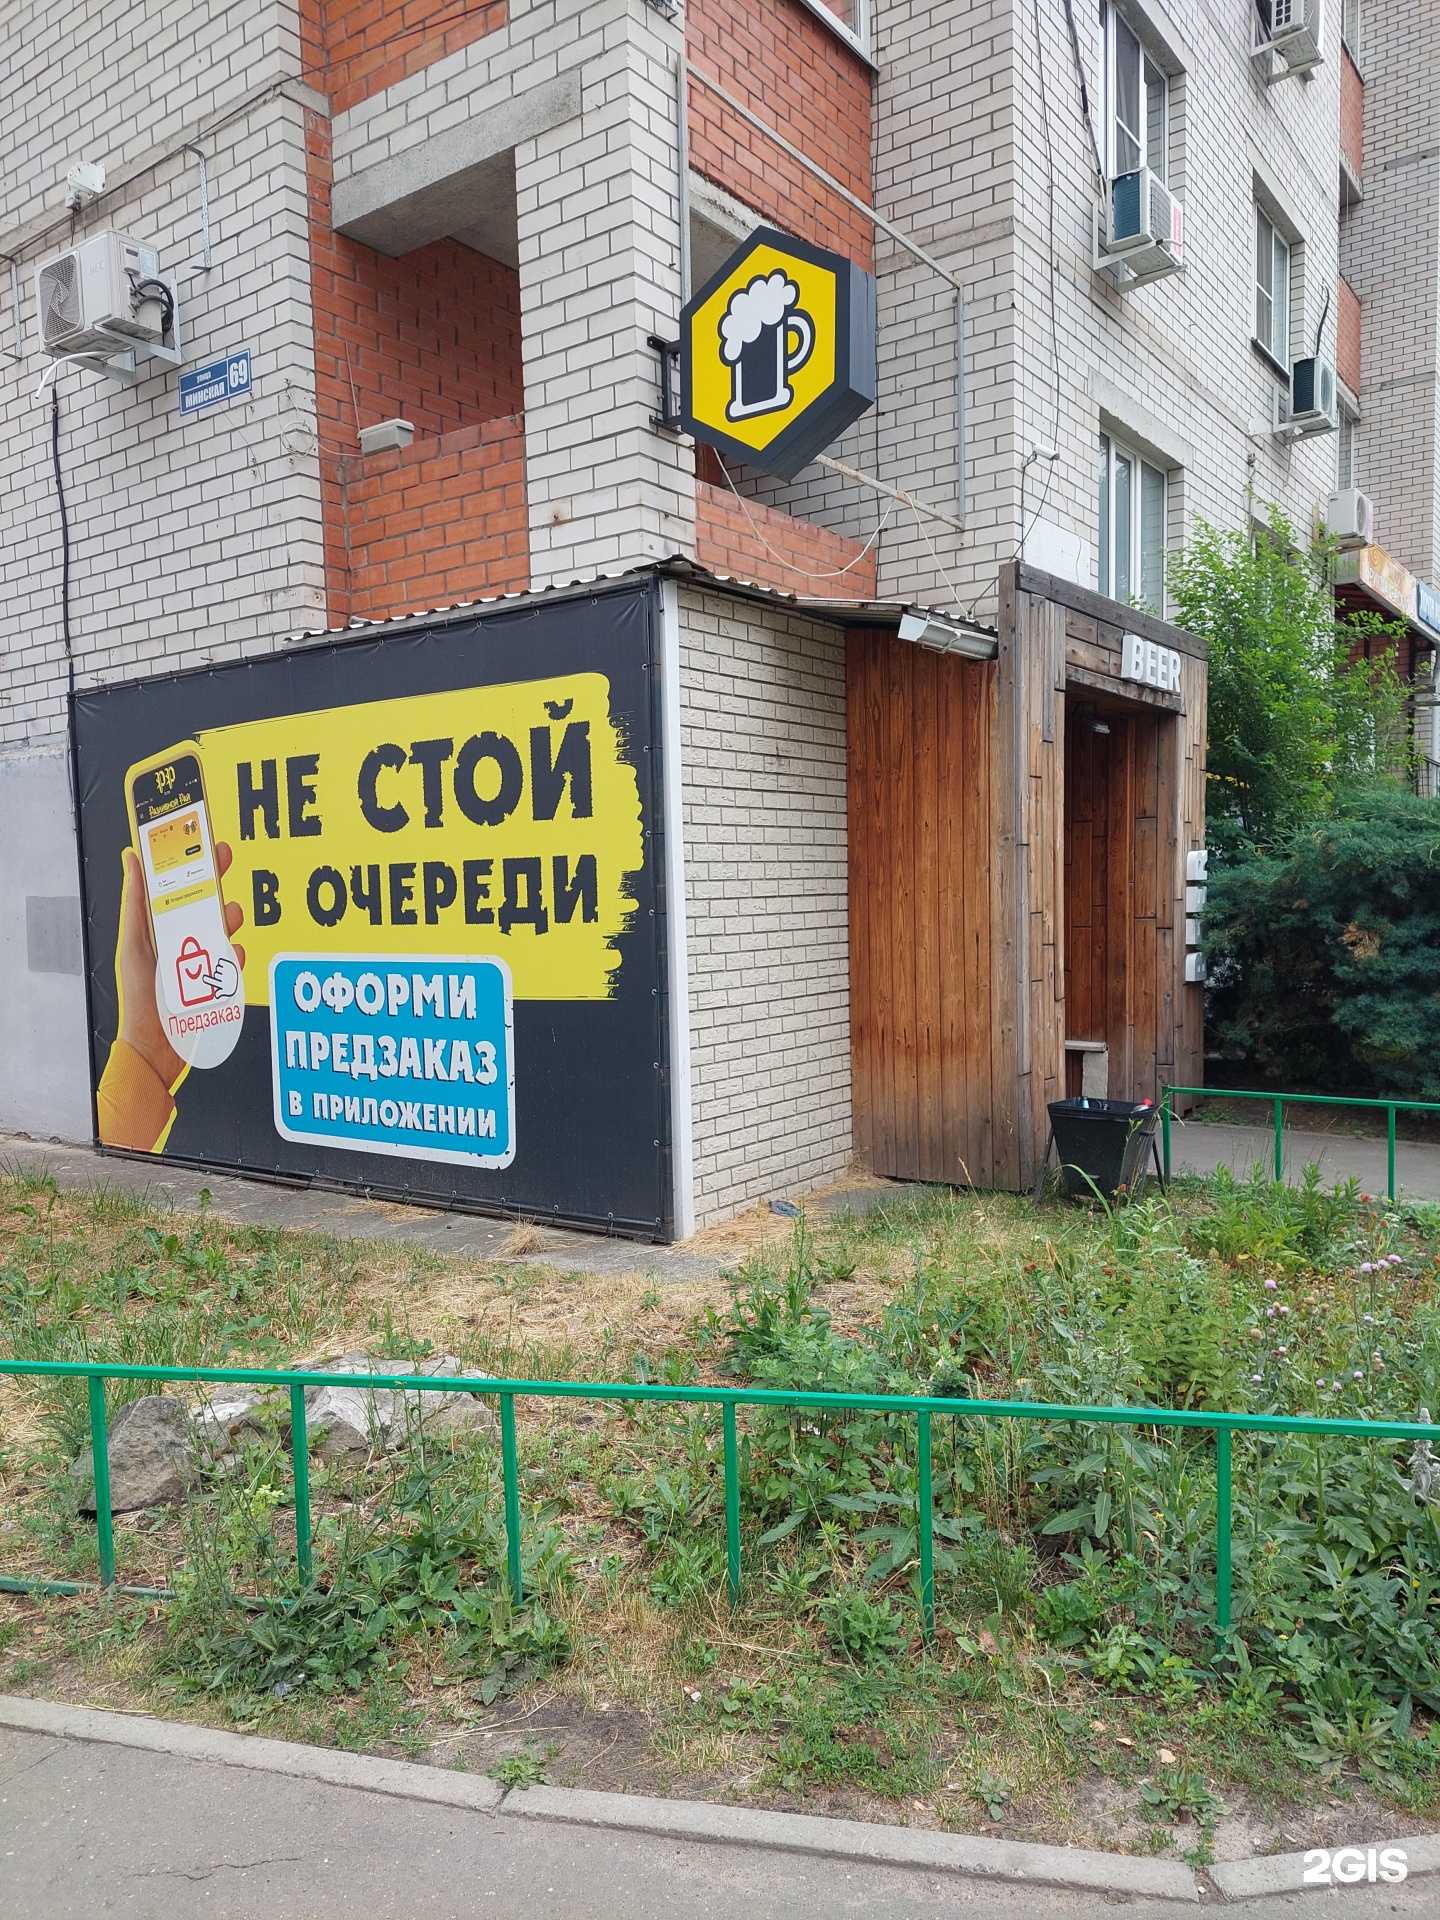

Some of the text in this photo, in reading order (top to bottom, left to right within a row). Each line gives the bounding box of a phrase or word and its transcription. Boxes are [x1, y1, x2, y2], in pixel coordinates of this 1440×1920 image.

[185, 382, 225, 408] МИНСКАЯ
[229, 359, 248, 388] 69
[1121, 635, 1181, 692] BEER
[237, 698, 594, 841] НЕ СТОЙ
[251, 854, 598, 936] В ОЧЕРЕДИ
[294, 971, 478, 1020] ОФОРМИ
[168, 1004, 241, 1039] Предзаказ
[285, 1030, 498, 1086] ПРЕДЗАКАЗ
[288, 1090, 497, 1139] В ПРИЛОЖЕНИИ
